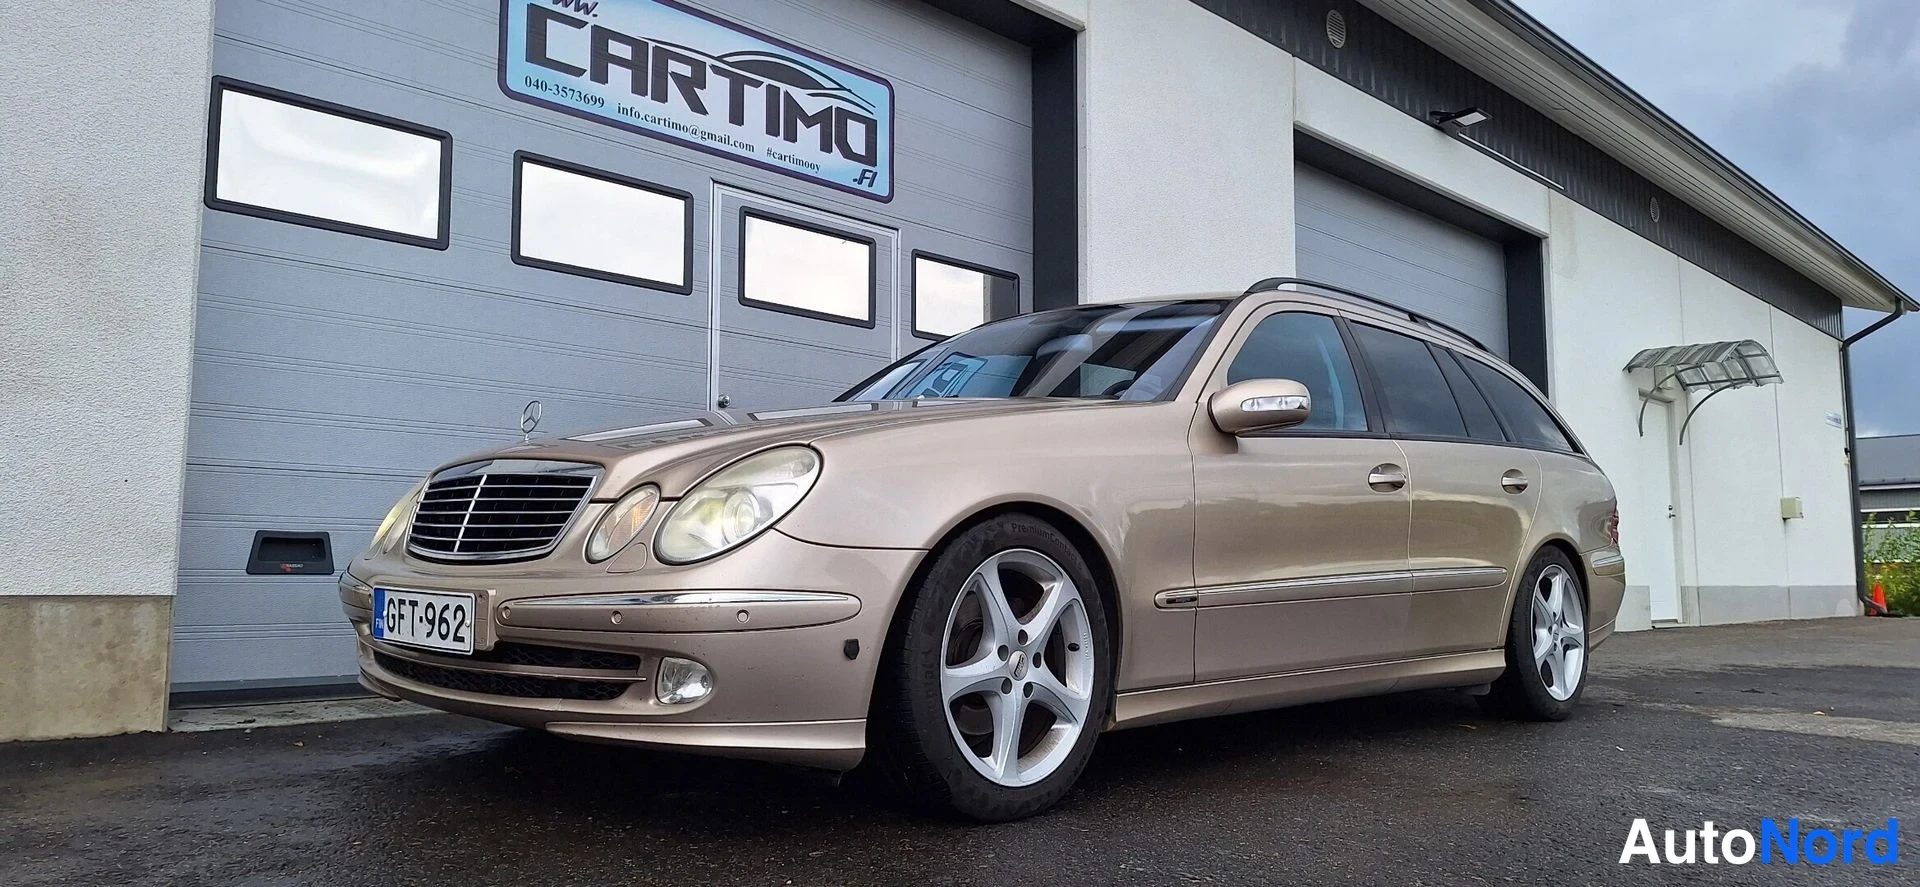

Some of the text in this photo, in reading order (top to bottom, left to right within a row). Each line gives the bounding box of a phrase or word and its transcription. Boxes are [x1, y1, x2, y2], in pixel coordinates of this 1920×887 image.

[524, 75, 821, 173] 040-3573699 info.cartimo@gmail.com #cartimooy
[525, 3, 877, 167] CARTIMO
[386, 597, 466, 643] GFT-962
